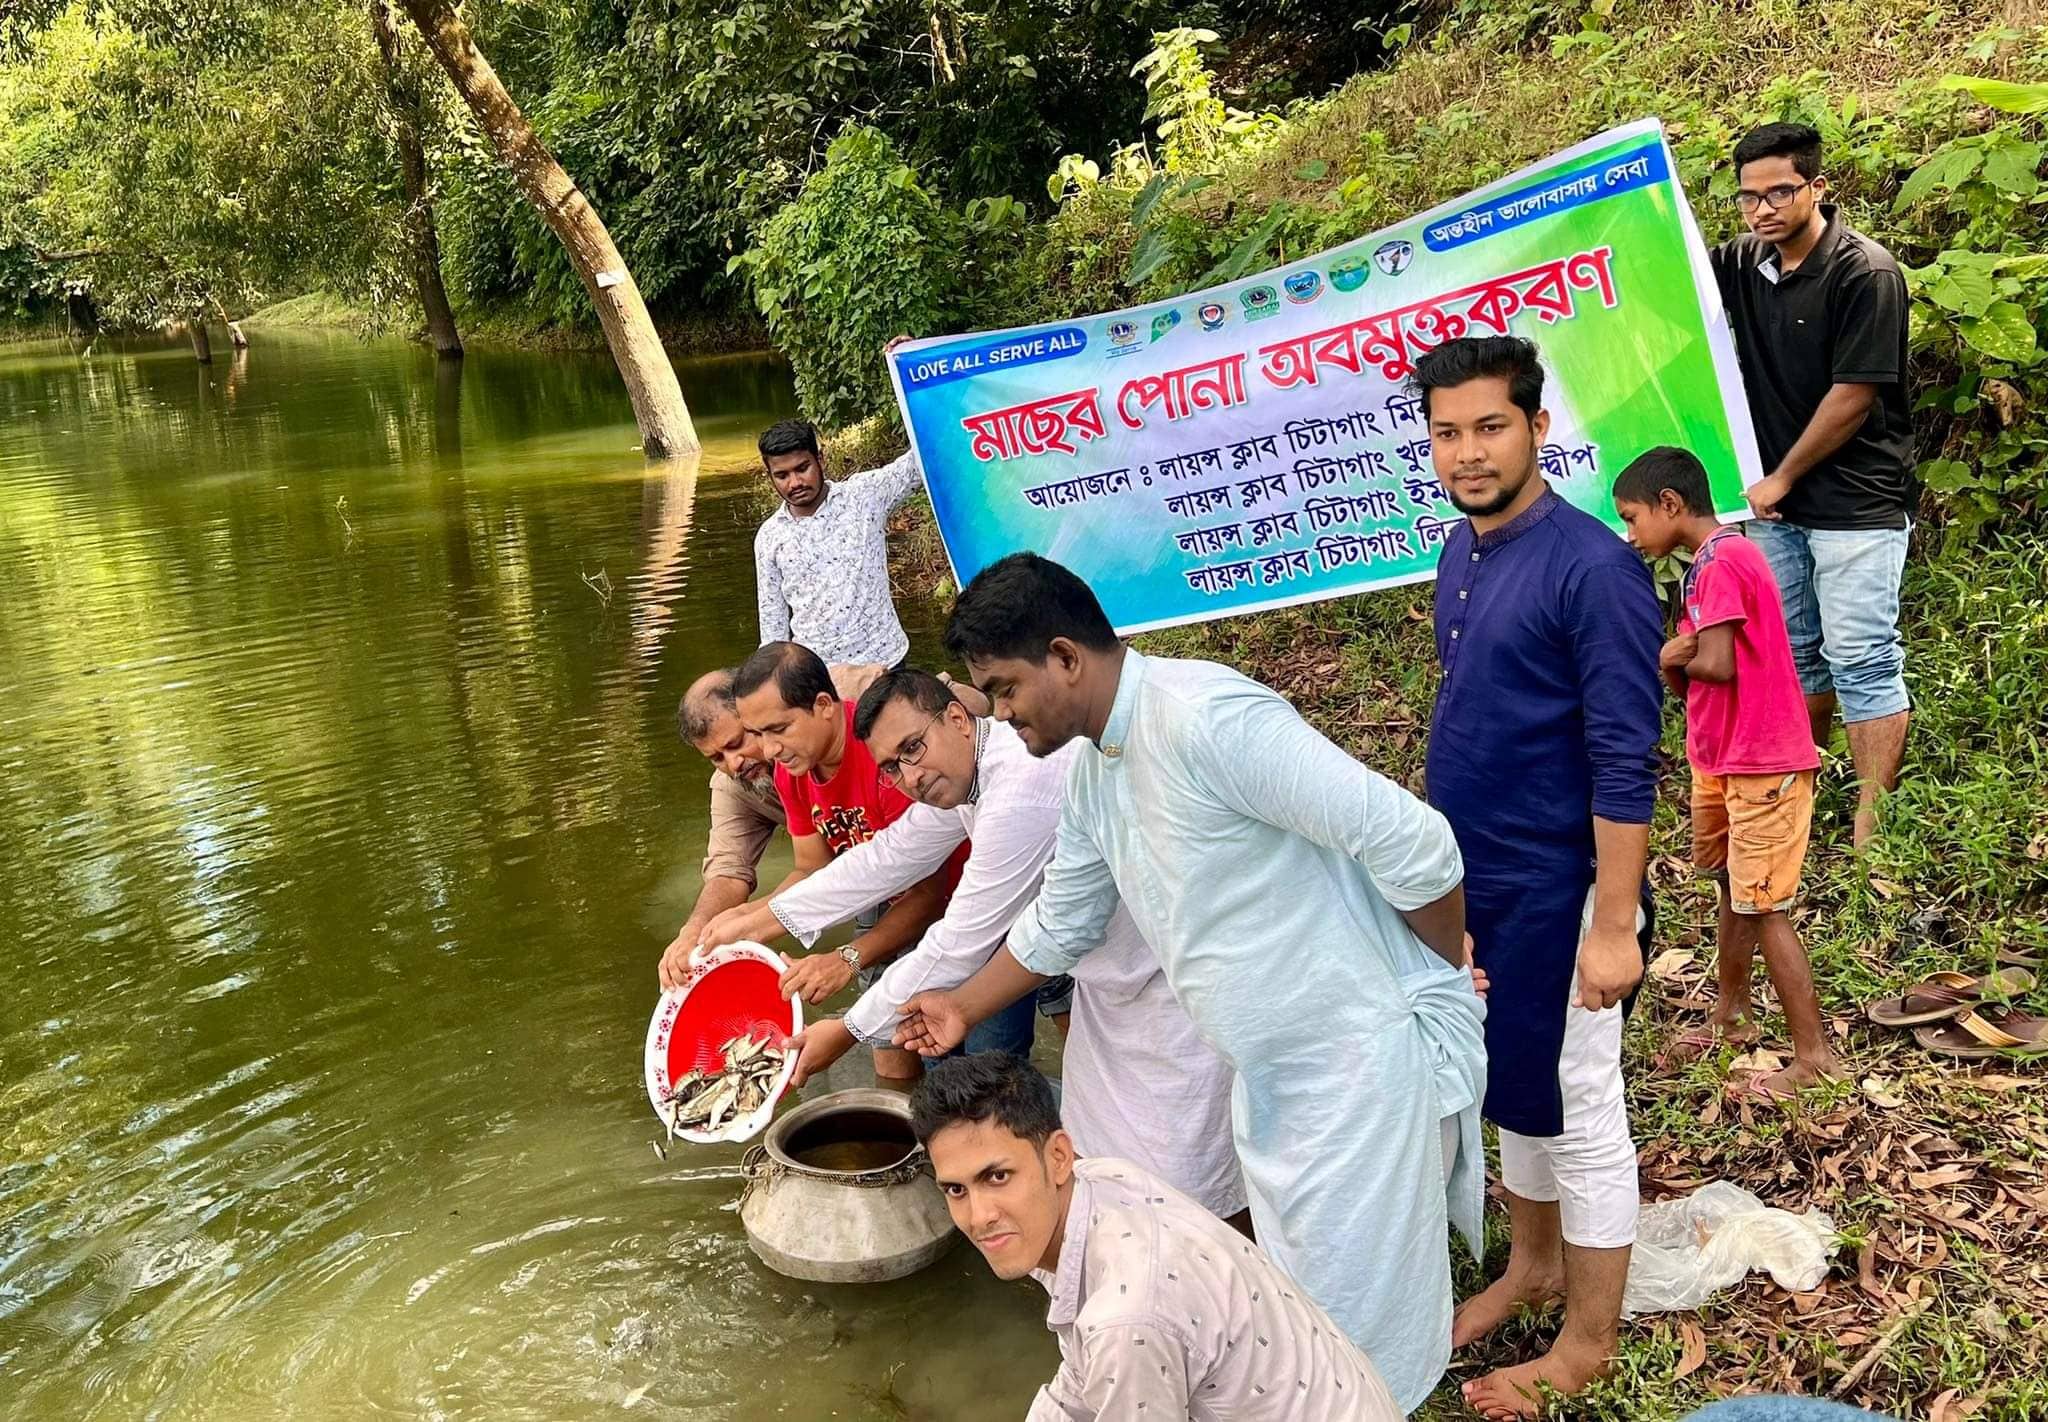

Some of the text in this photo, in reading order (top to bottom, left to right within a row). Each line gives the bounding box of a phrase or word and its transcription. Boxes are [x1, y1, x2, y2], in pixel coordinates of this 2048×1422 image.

[1430, 156, 1649, 242] অন্তহীন ভালোবাসায় সেবা
[909, 332, 1081, 383] LOVE ALL SERVE ALL
[963, 247, 1616, 460] মাছের পোনা অবমুক্তকরণ
[1024, 468, 1132, 509] আয়োজনে
[1156, 448, 1223, 481] লায়ন্স
[1226, 435, 1279, 470] ক্লাব
[1283, 411, 1384, 454] চিটাগাং
[1164, 485, 1232, 517] লায়ন্স
[1236, 472, 1288, 507] ক্লাব
[1292, 450, 1393, 493] চিটাগাং
[1176, 443, 1597, 555] লায়ন্স ক্লাব চিটাগাং ইম ন্দ্বীপ
[1186, 515, 1465, 593] লায়ন্স ক্লাব চিটাগাং লি
